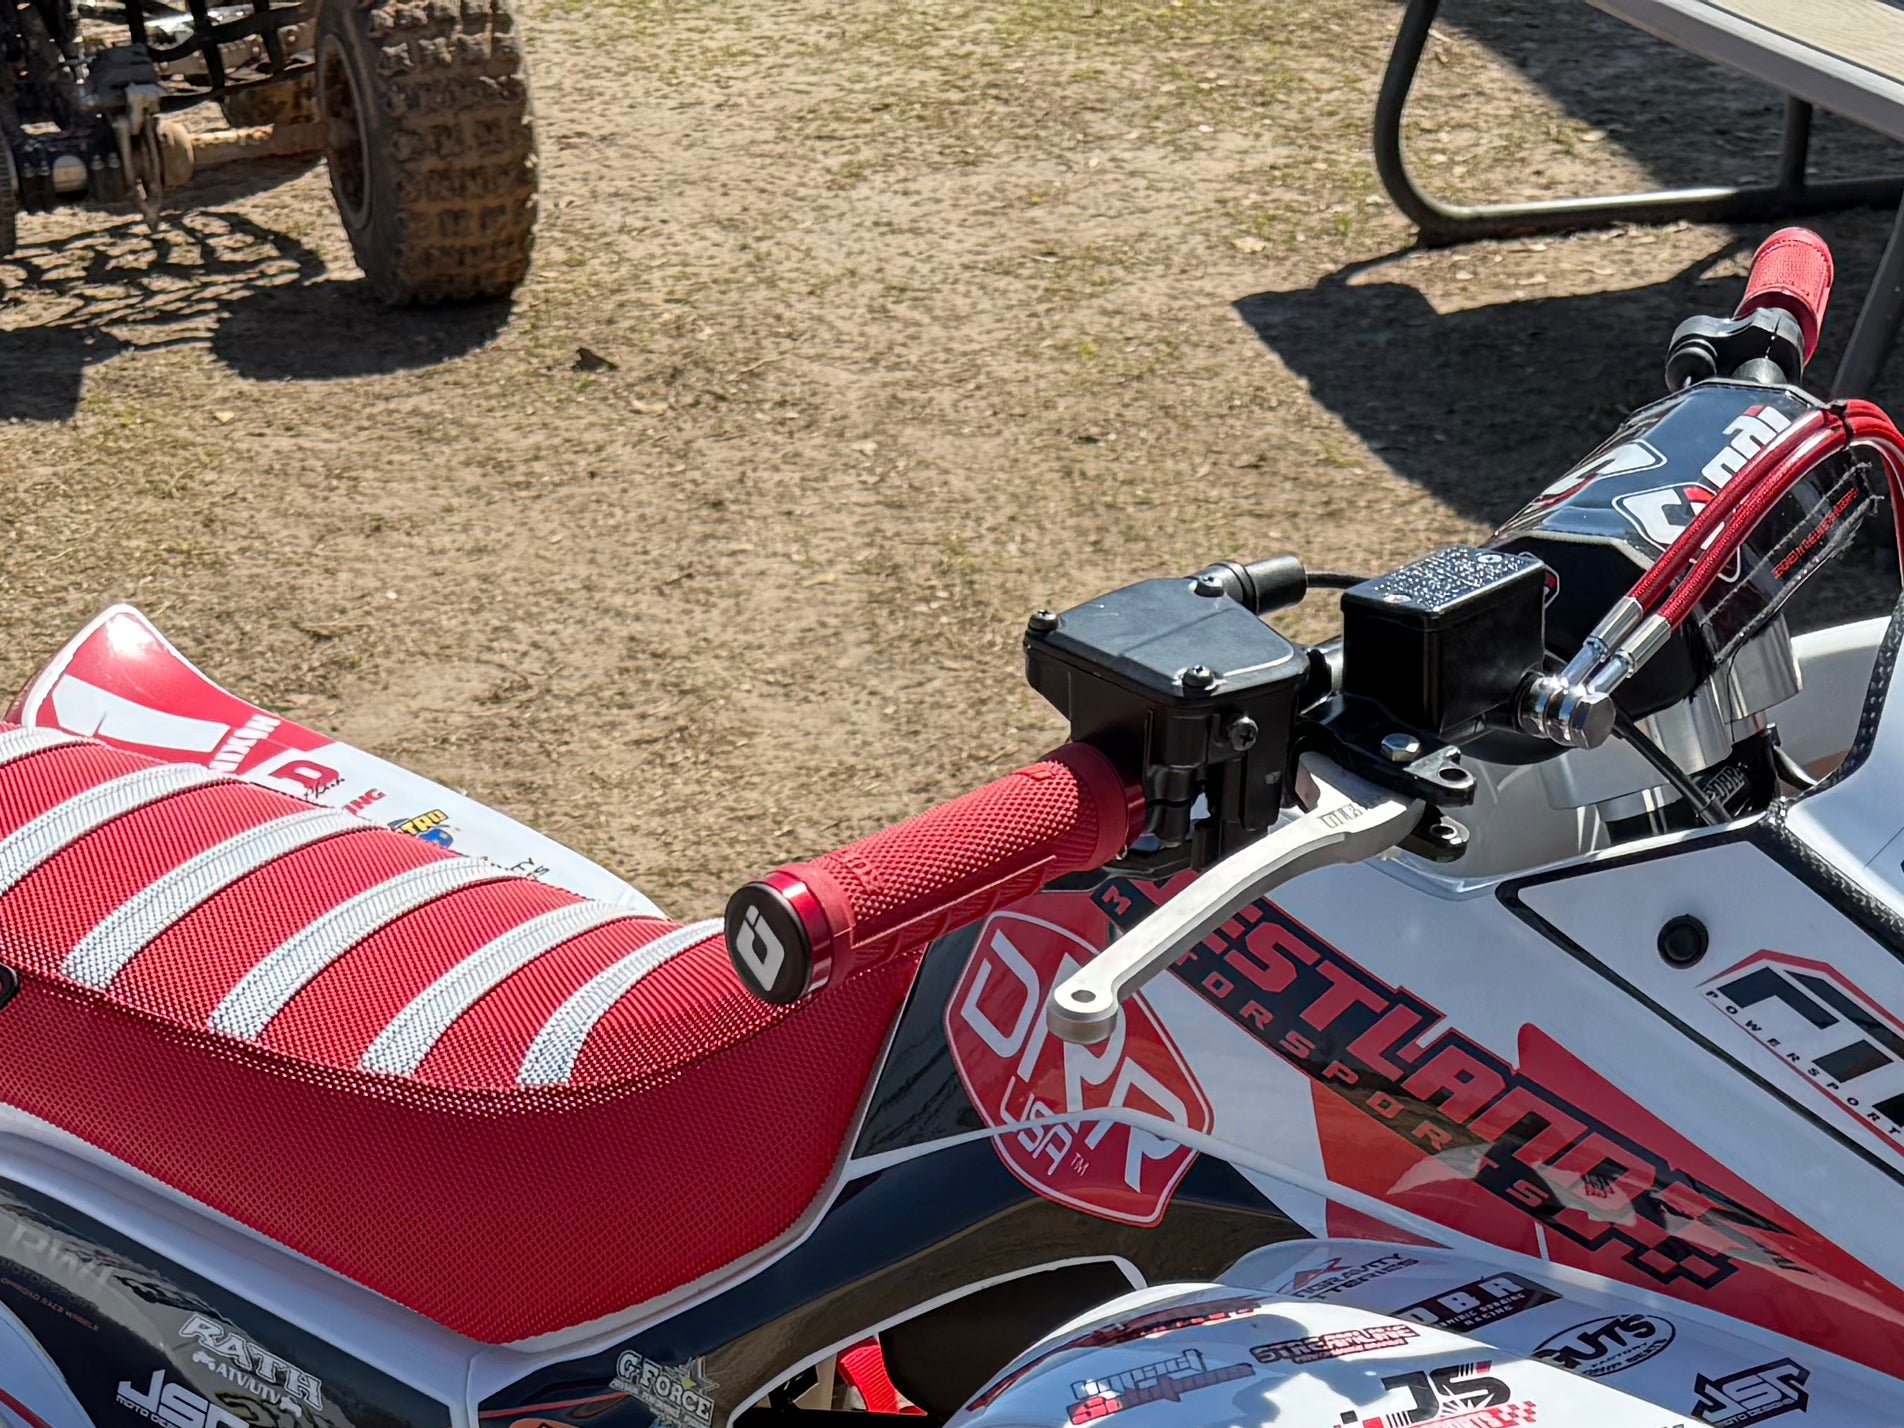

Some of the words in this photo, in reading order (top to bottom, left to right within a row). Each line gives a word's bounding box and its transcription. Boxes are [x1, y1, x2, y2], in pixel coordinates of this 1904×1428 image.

[1148, 870, 1656, 1228] ESTLAND
[1000, 1076, 1072, 1176] USA
[179, 1313, 324, 1412] RATH
[1381, 1361, 1512, 1424] JS
